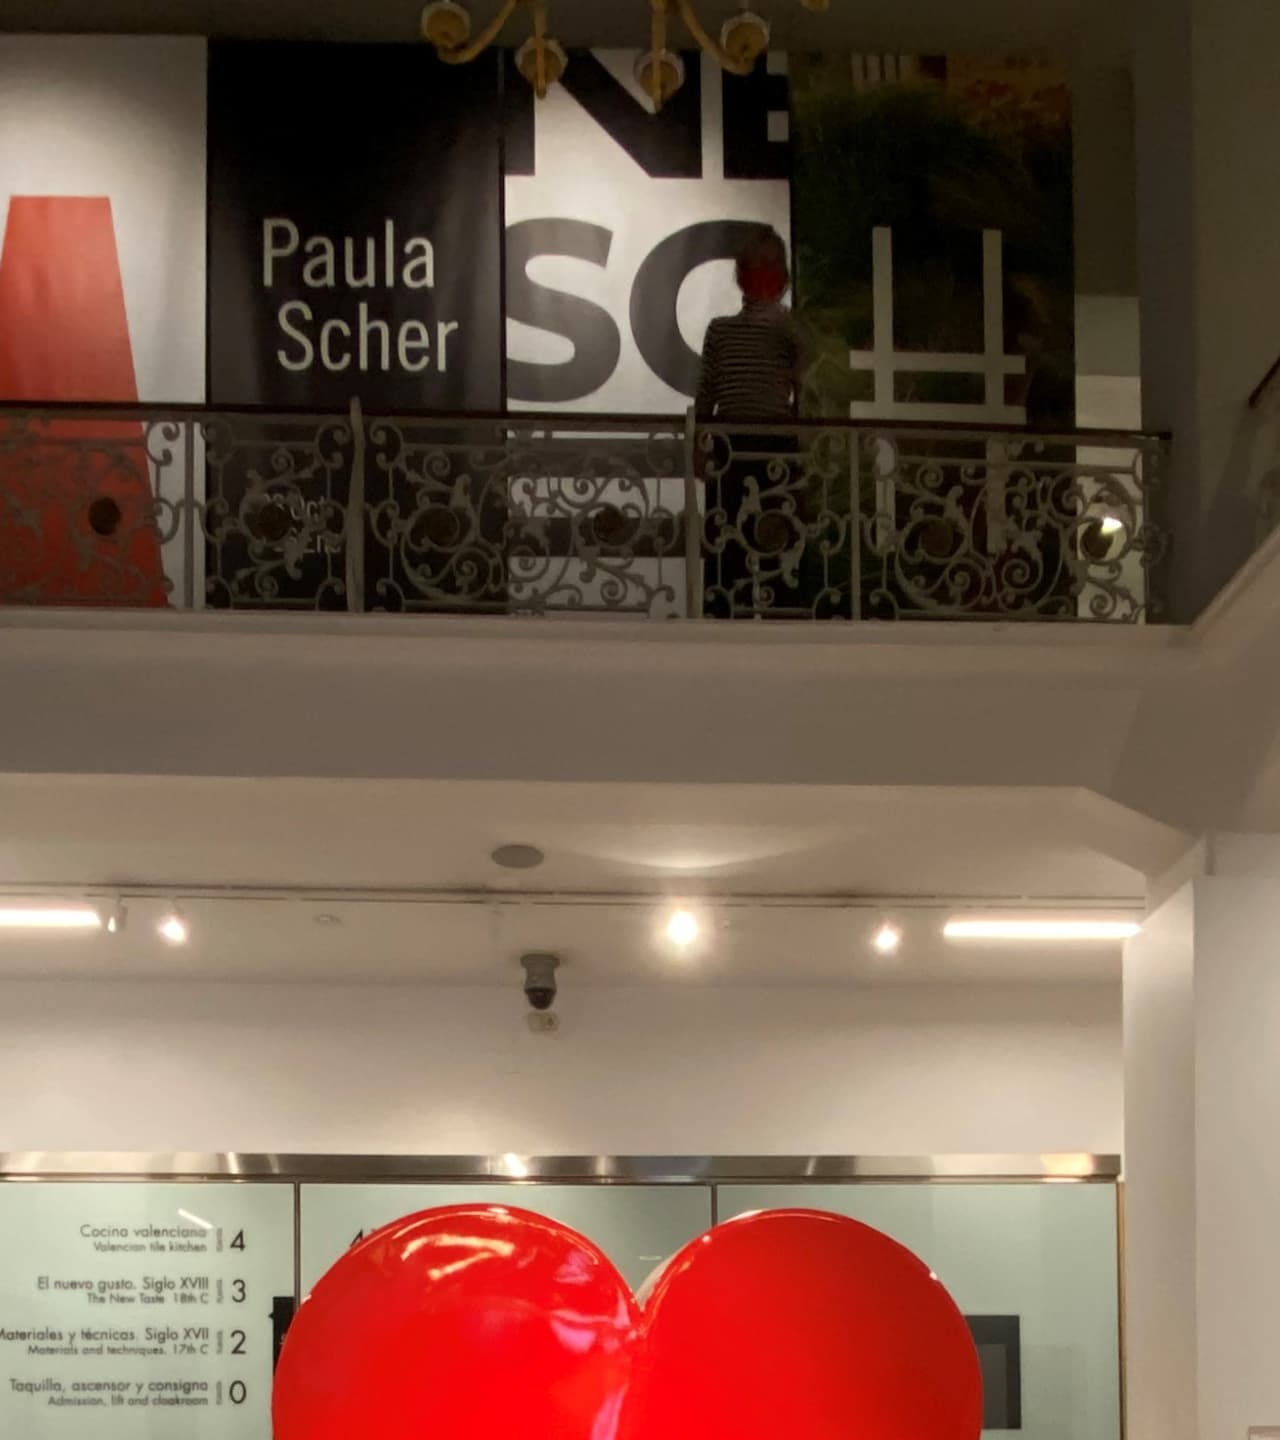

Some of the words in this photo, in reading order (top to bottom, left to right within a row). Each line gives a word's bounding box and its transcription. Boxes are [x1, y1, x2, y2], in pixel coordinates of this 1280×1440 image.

[263, 217, 435, 289] Paula
[277, 299, 459, 372] Scher
[80, 1224, 129, 1239] Cocina
[133, 1224, 207, 1239] valenciana
[229, 1228, 246, 1252] 4
[37, 1276, 49, 1290] El
[54, 1279, 94, 1291] nuevo
[142, 1276, 177, 1294] Siglo
[180, 1276, 209, 1290] XVIII
[232, 1278, 246, 1303] 3
[87, 1292, 106, 1304] The
[109, 1292, 136, 1304] New
[68, 1331, 76, 1345] y
[144, 1326, 179, 1344] Siglo
[183, 1327, 209, 1341] XVII
[230, 1329, 247, 1355] 2
[82, 1344, 103, 1356] and
[71, 1382, 131, 1392] ascensor
[136, 1382, 144, 1395] y
[148, 1379, 208, 1395] consigna
[229, 1380, 247, 1405] 0
